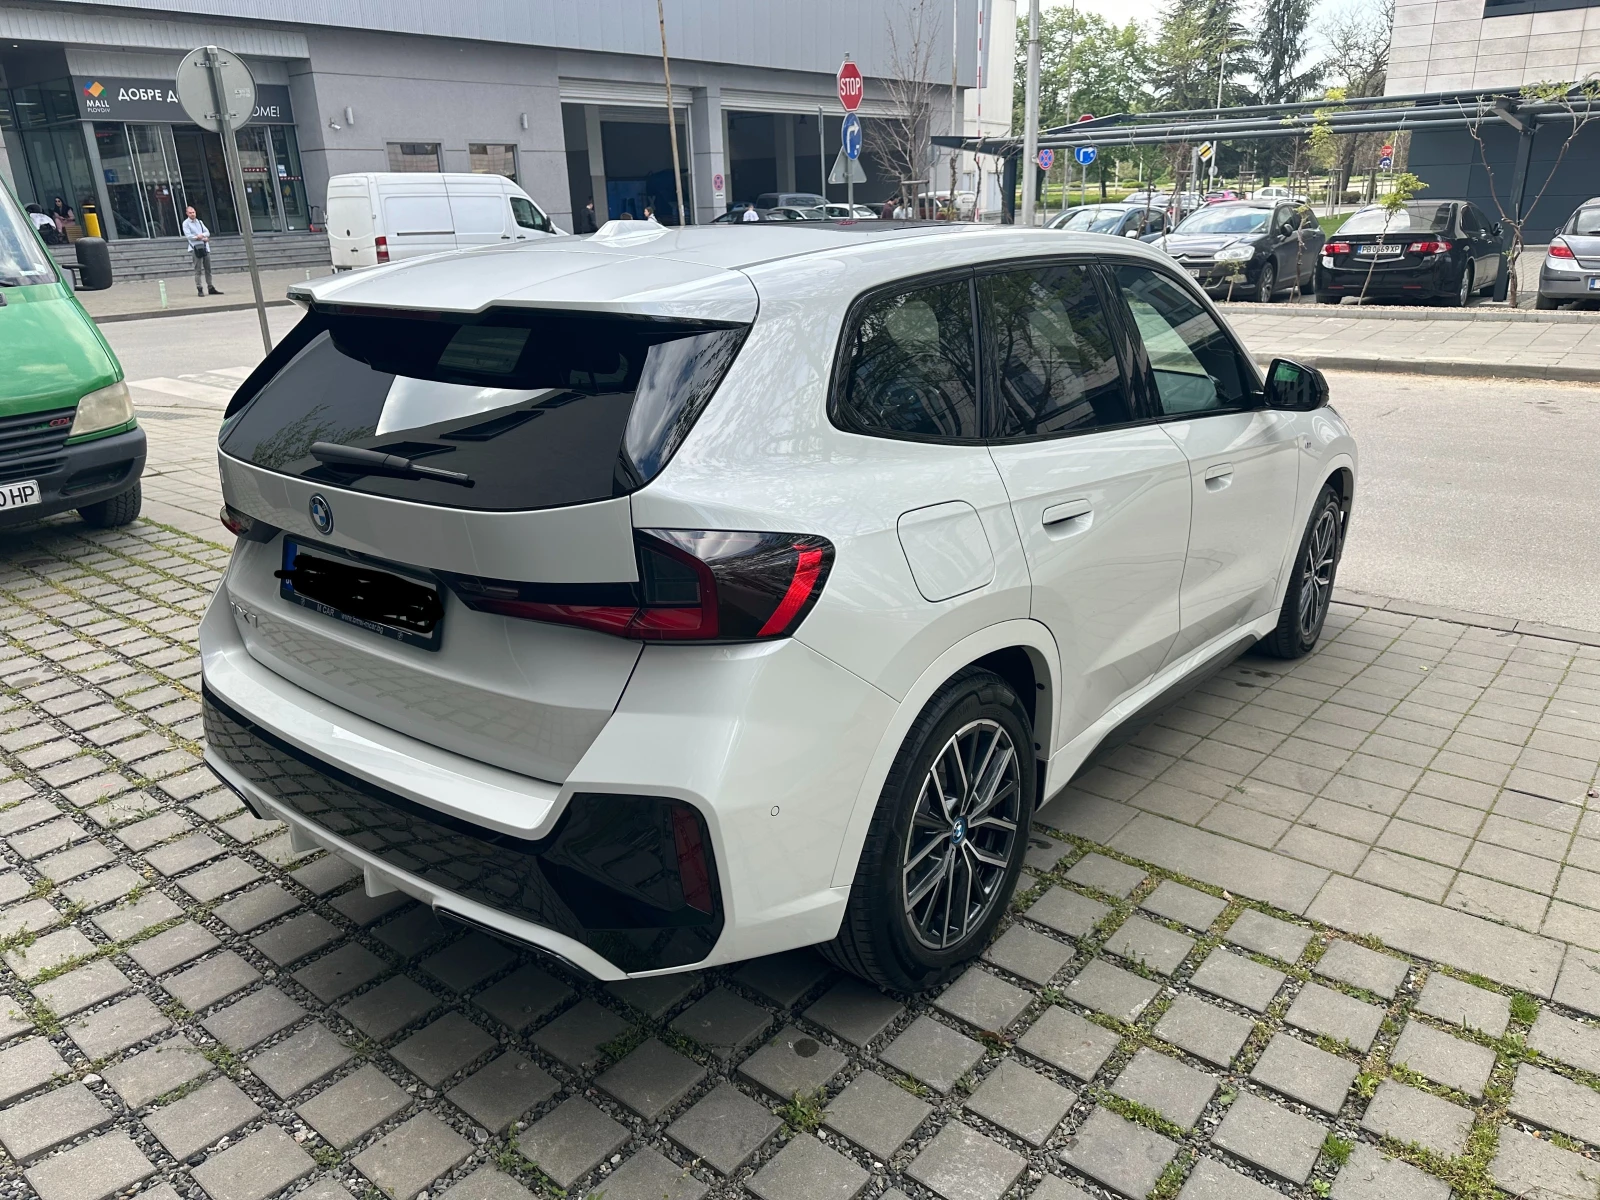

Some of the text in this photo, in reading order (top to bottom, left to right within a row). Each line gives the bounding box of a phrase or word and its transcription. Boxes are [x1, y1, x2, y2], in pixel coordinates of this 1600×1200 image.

[840, 78, 861, 96] STOP
[118, 87, 179, 103] ДОБРЕ Д
[86, 99, 110, 108] MALL
[49, 417, 70, 428] CDI
[10, 485, 35, 505] HP
[322, 605, 335, 617] CAR
